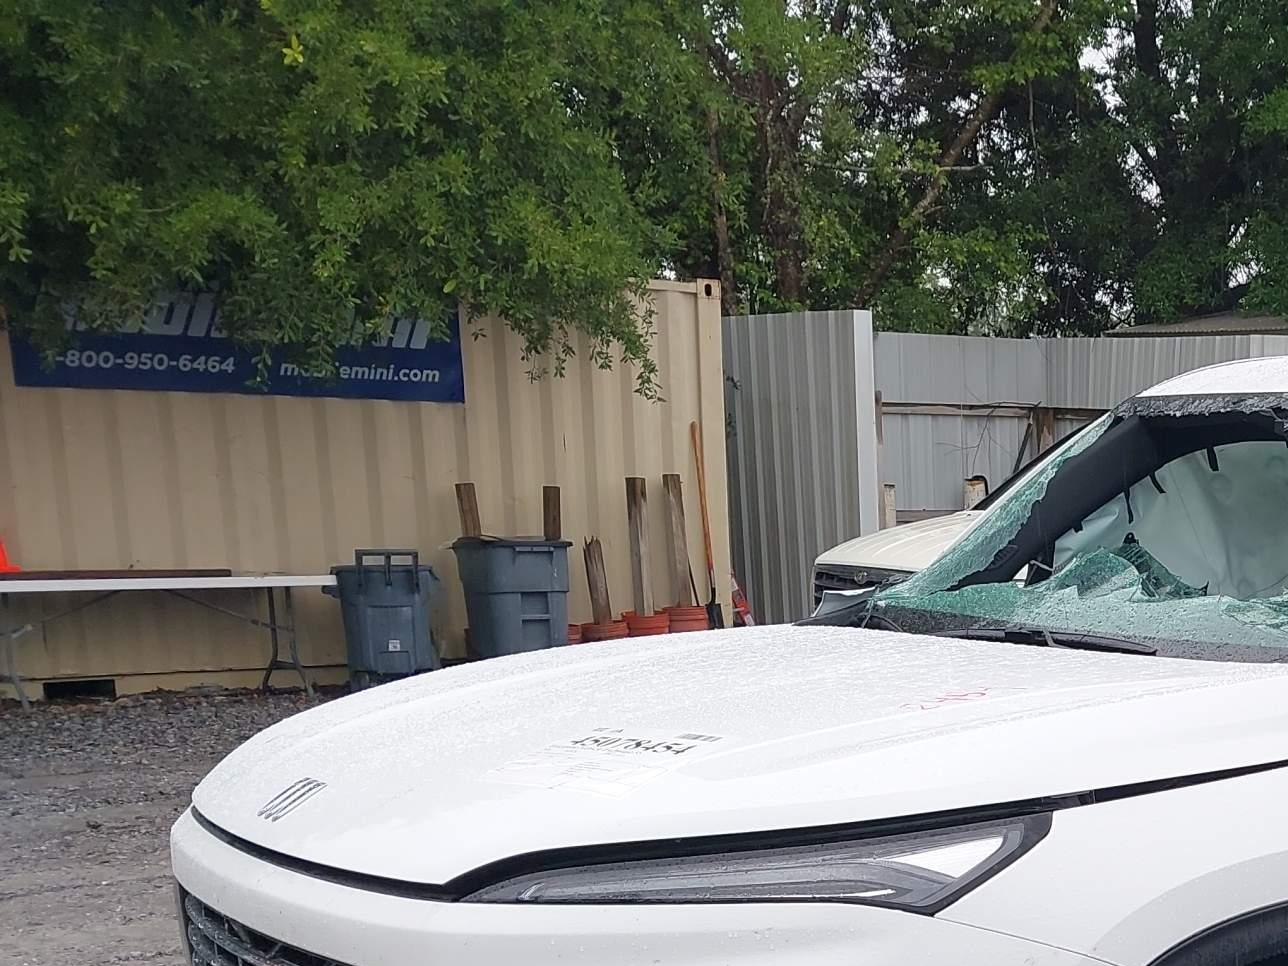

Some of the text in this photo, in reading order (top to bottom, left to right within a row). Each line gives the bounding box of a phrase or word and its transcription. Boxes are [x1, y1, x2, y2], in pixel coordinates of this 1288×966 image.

[55, 350, 440, 383] -800-950-6464 memini.com
[570, 735, 697, 755] 45078454
